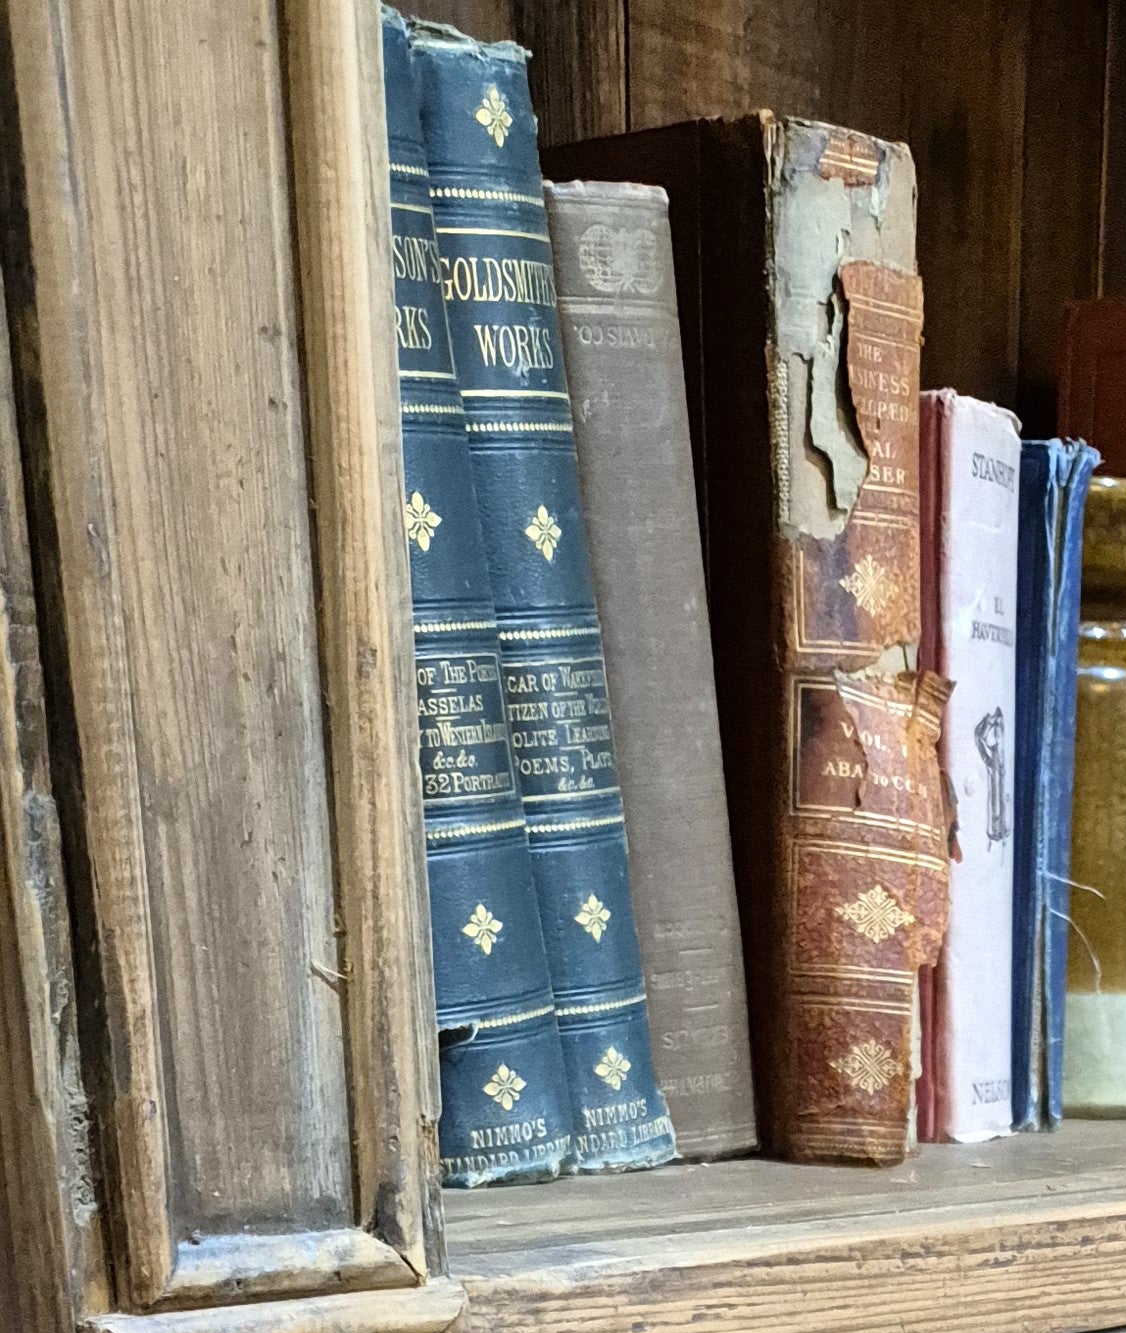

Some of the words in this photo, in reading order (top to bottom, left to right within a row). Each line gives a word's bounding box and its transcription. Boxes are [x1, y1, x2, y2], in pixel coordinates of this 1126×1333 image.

[393, 235, 441, 284] SON'S
[395, 306, 432, 350] RKS
[474, 324, 554, 369] WORKS
[858, 342, 882, 363] THE
[418, 667, 436, 686] OF
[440, 660, 467, 684] THE
[507, 674, 539, 693] CAR
[542, 673, 558, 691] OF
[418, 694, 484, 716] ASSELAS
[507, 702, 548, 721] TIZEN
[512, 730, 558, 748] OLITE
[821, 760, 864, 778] ABA
[424, 773, 451, 794] 32
[582, 1099, 648, 1129] NIMMO'S
[470, 1118, 547, 1150] NIMMO'S
